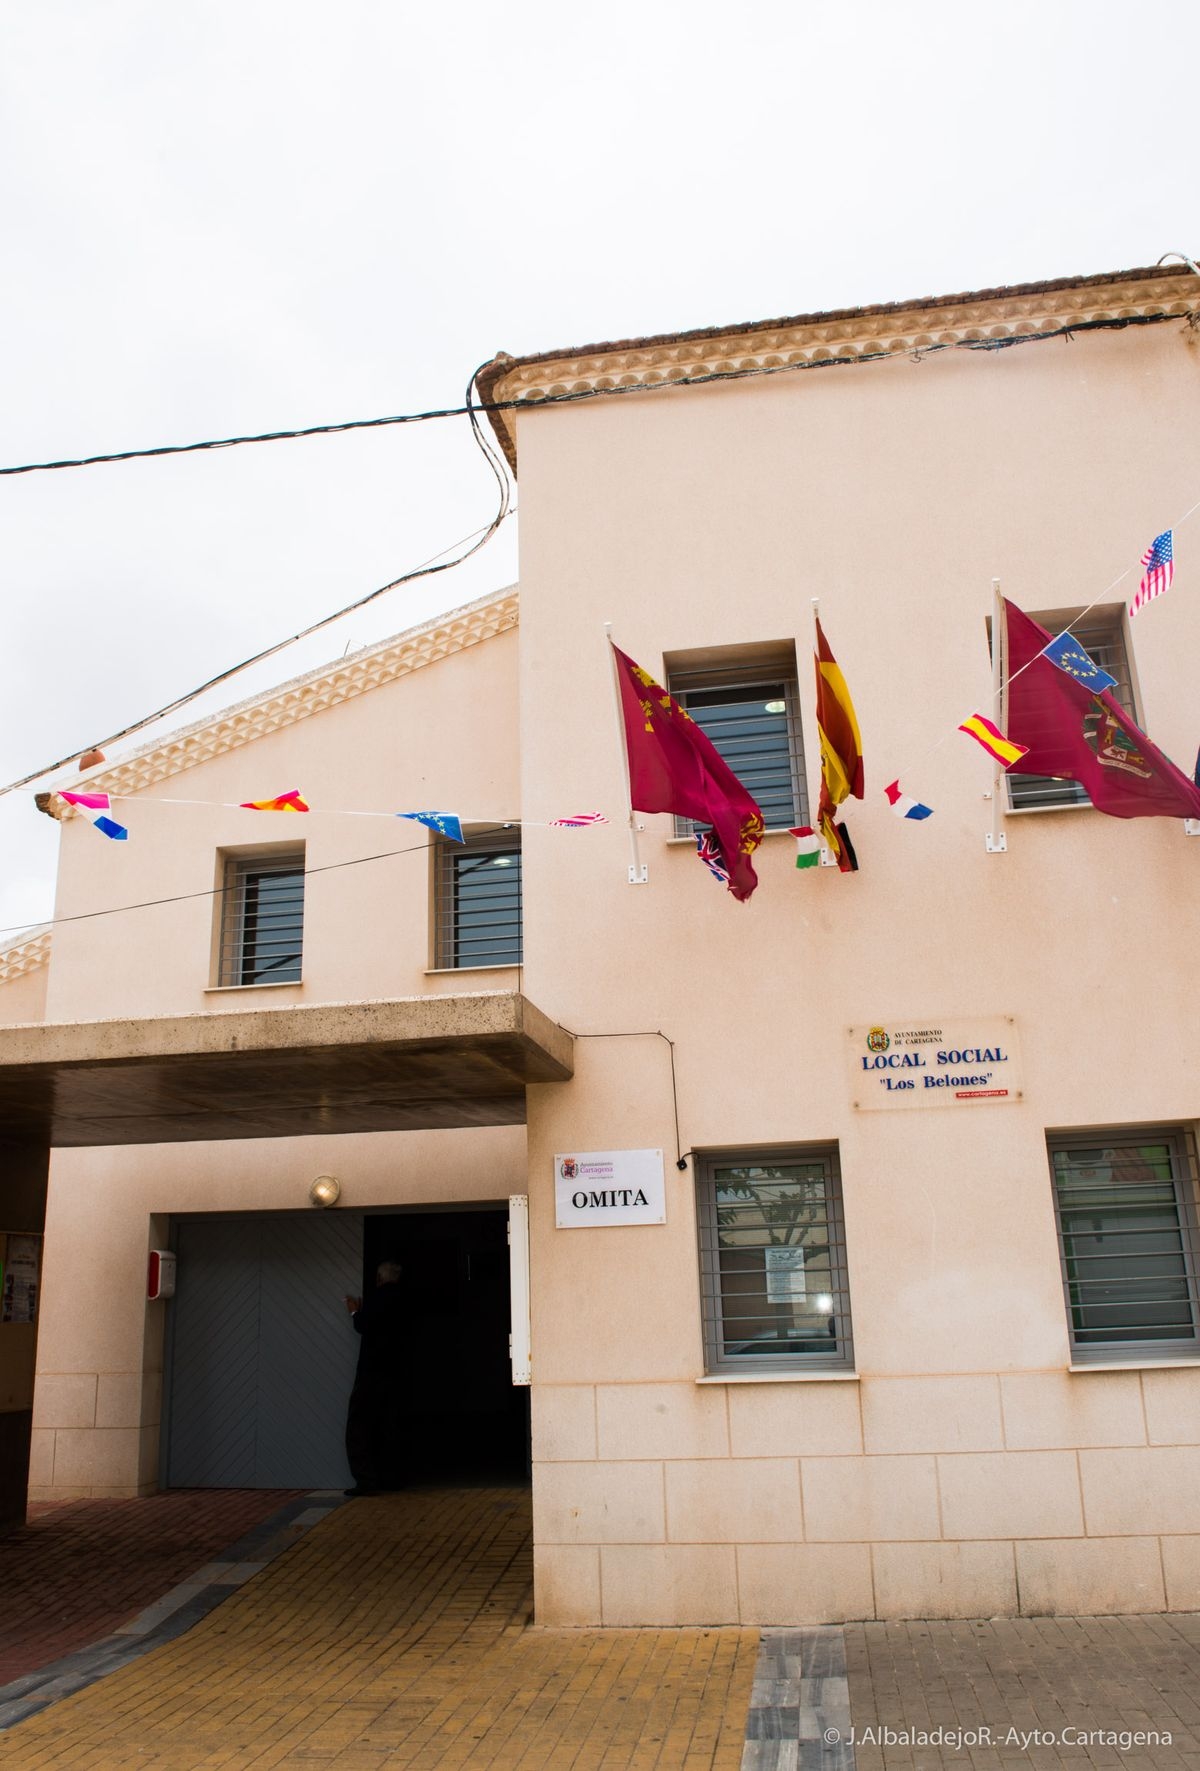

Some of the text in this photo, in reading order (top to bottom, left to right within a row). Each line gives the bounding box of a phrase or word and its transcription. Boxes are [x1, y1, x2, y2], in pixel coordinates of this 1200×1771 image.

[894, 1029, 942, 1038] AYUNTAMIENTO
[905, 1037, 943, 1045] CARTAGENA
[862, 1047, 1008, 1070] LOCAL SOCIAL
[880, 1072, 993, 1090] "Los Belones"
[580, 1166, 614, 1174] Cartagena
[571, 1188, 650, 1209] OMITA
